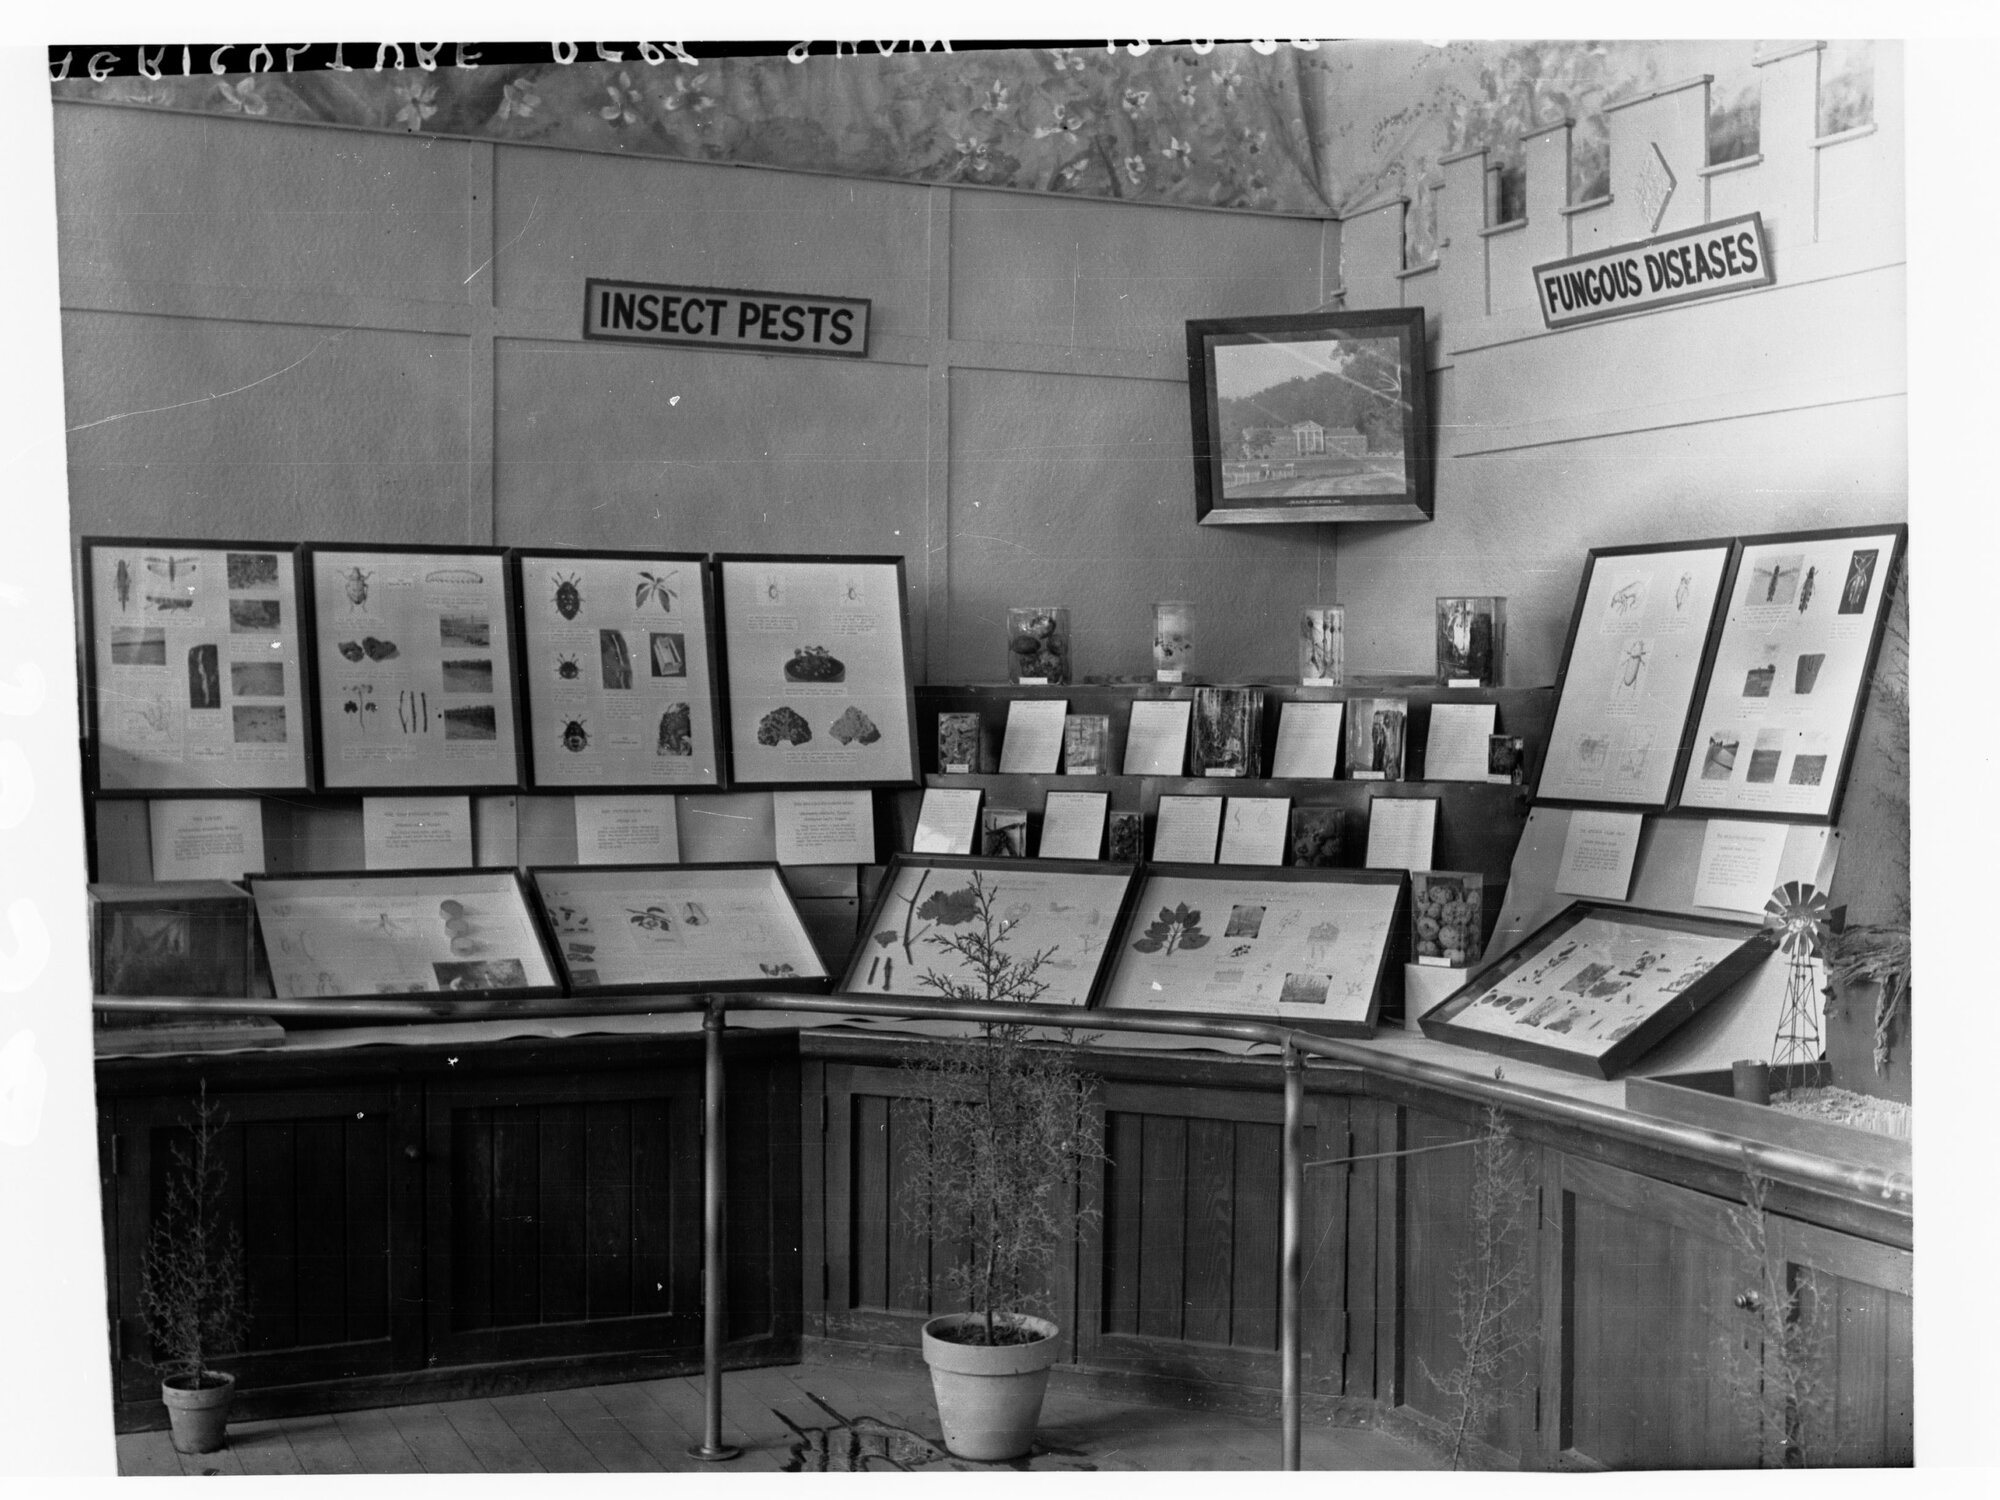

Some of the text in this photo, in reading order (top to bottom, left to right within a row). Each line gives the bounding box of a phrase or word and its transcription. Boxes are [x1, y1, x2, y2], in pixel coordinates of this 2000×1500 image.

[1544, 232, 1758, 313] FUNGOUS DISEASES
[600, 291, 854, 345] INSECT PESTS
